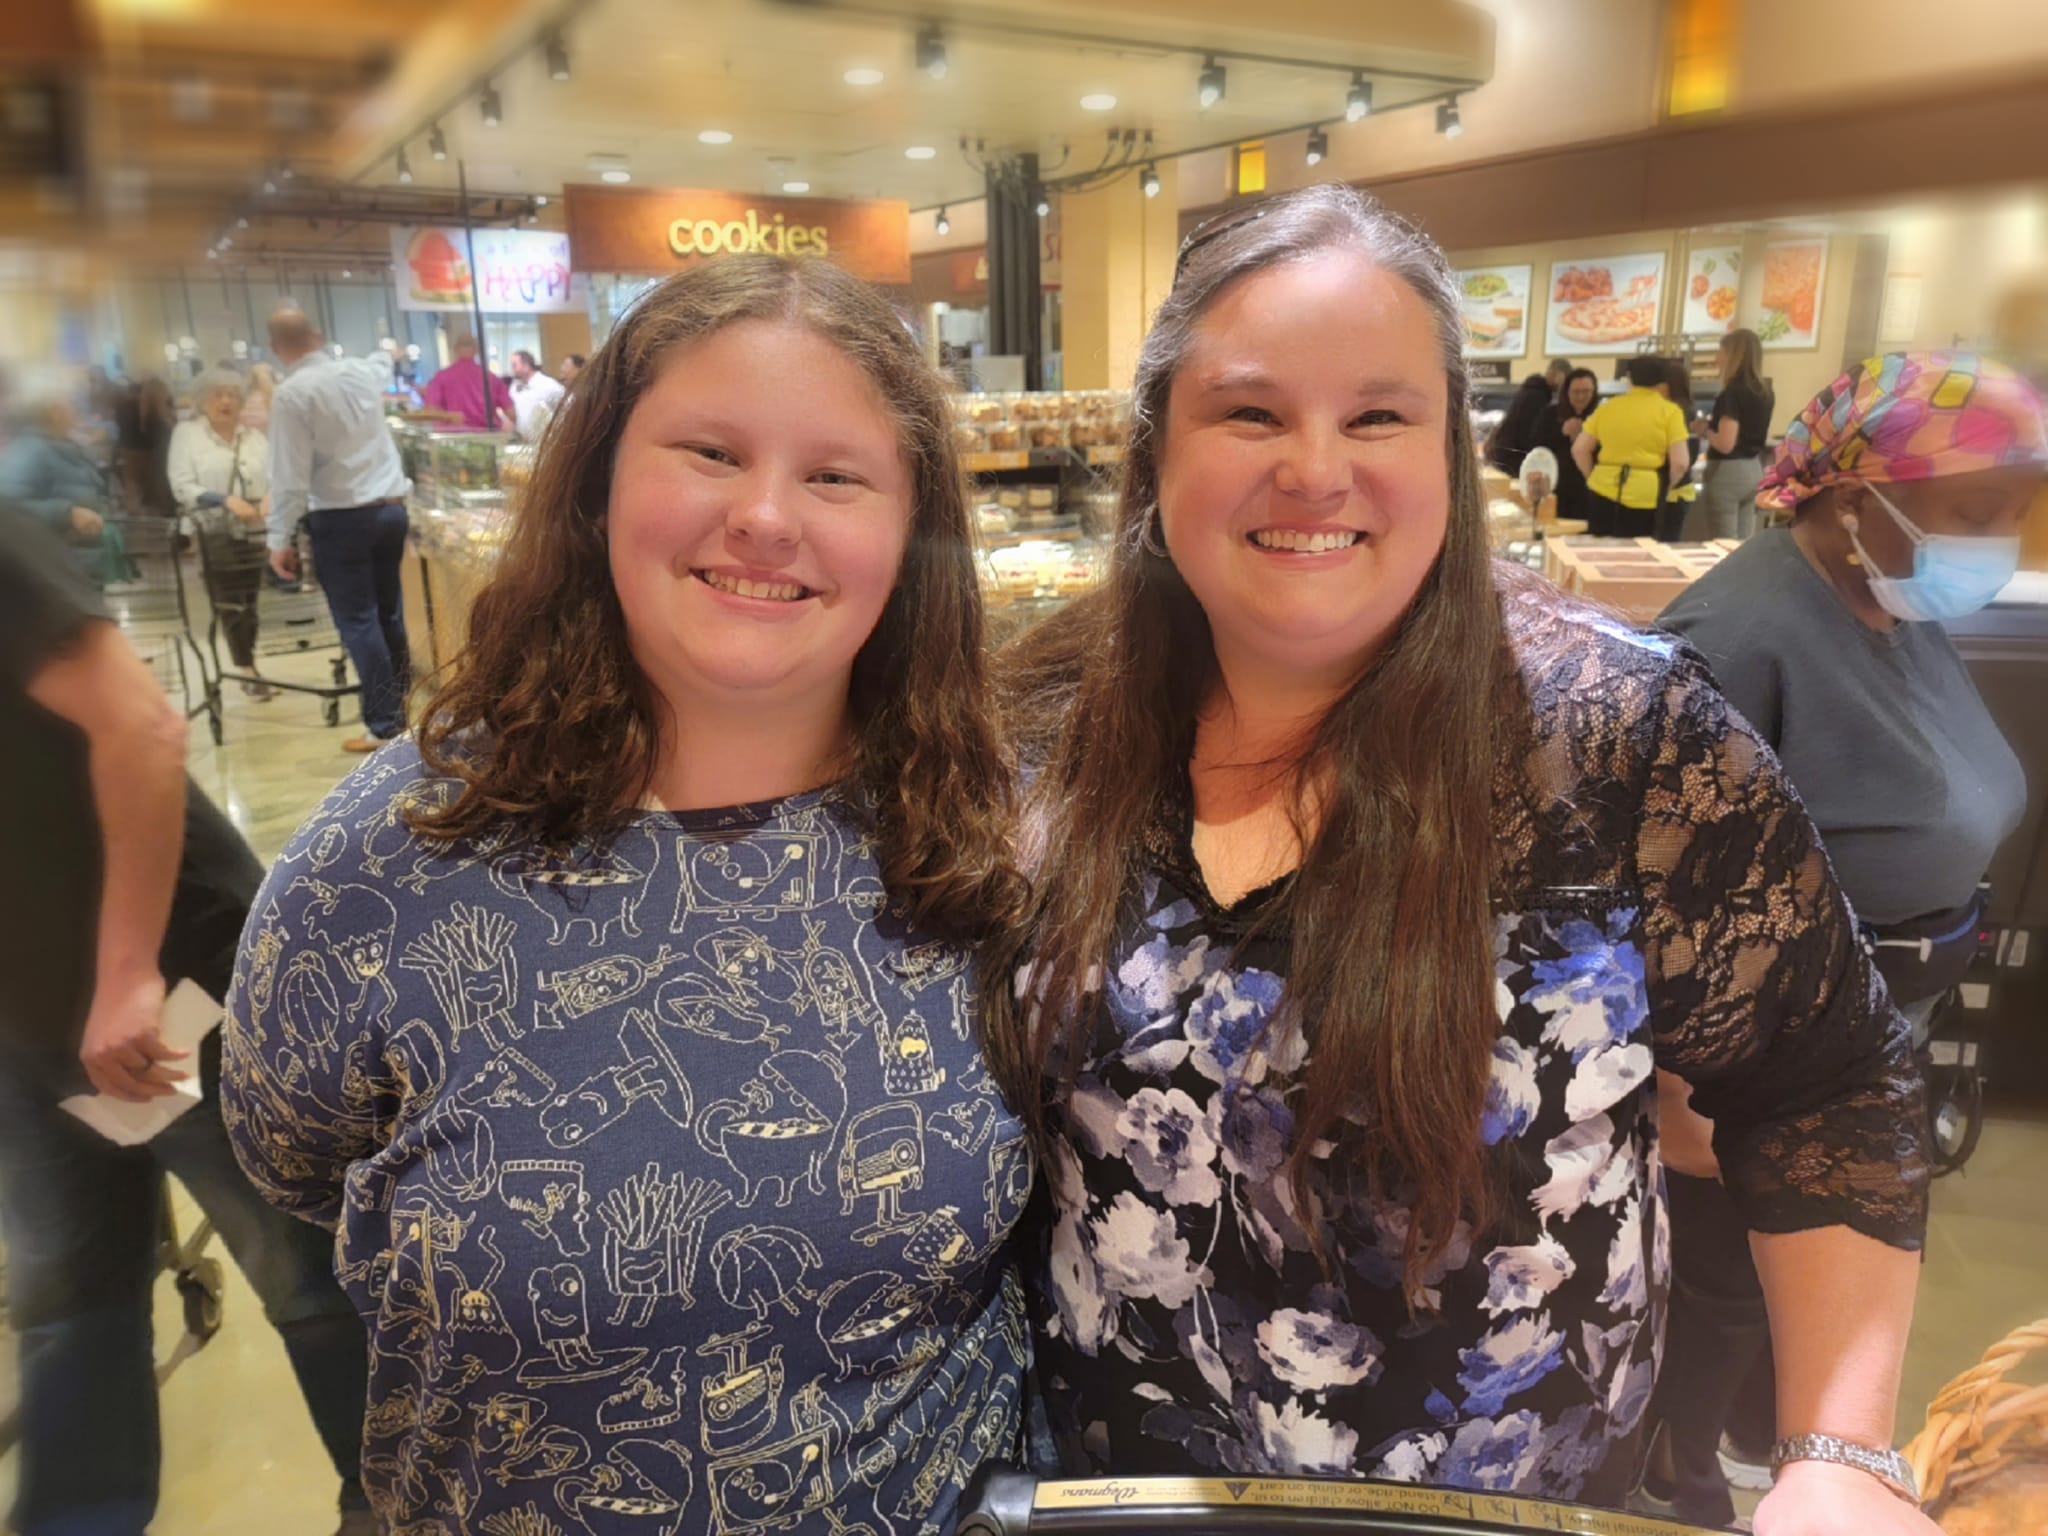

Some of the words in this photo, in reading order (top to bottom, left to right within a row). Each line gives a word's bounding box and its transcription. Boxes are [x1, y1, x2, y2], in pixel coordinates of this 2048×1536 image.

[669, 209, 828, 257] cookies
[1288, 1482, 1304, 1491] on
[1308, 1482, 1345, 1494] climb
[1346, 1486, 1361, 1495] or
[1062, 1481, 1139, 1504] Wegmans
[1270, 1494, 1285, 1503] to
[1286, 1494, 1342, 1507] children
[1345, 1498, 1381, 1509] allow
[1386, 1500, 1415, 1512] NOT
[1418, 1504, 1440, 1515] DO
